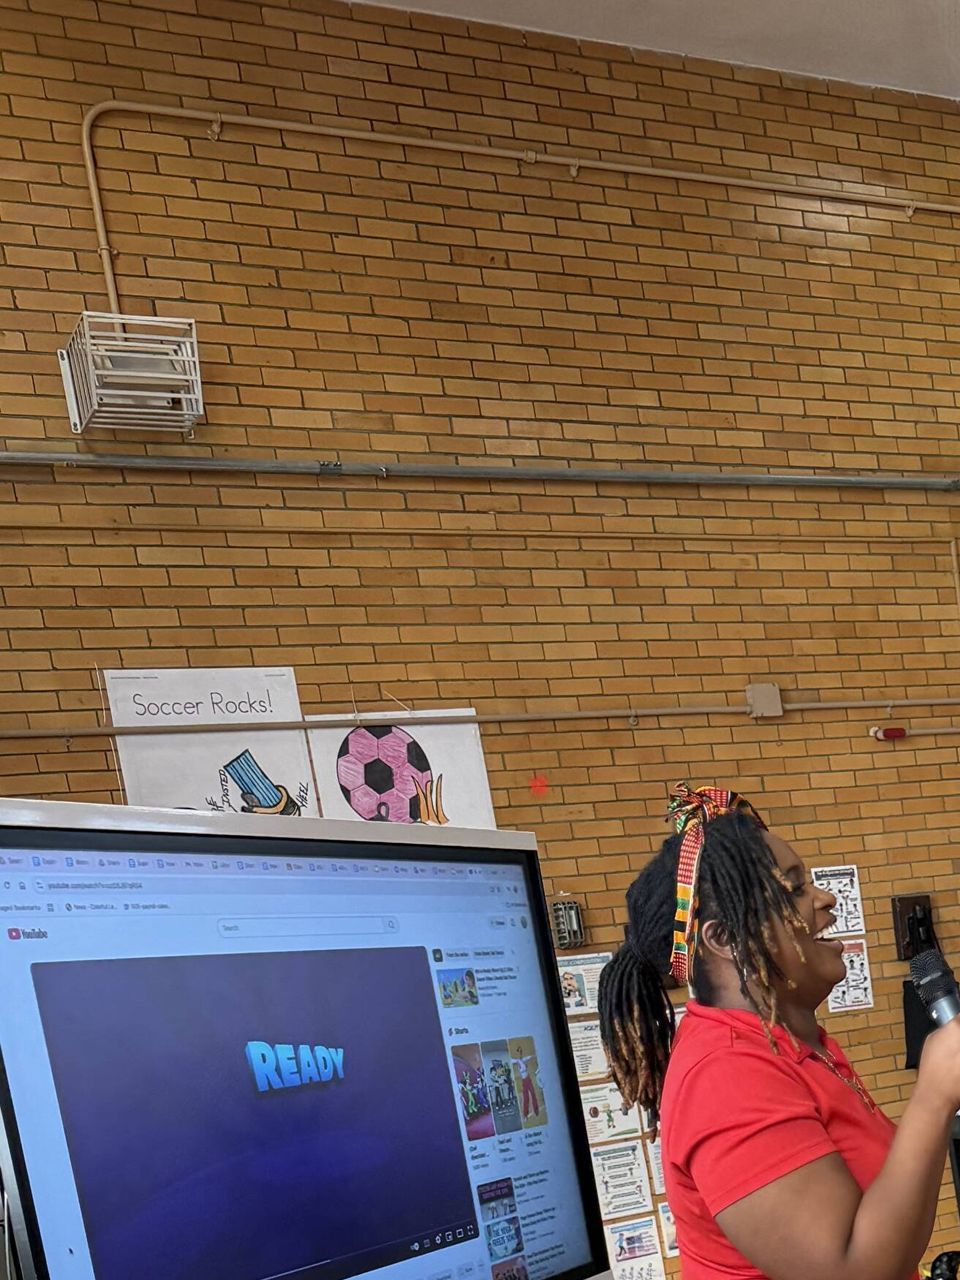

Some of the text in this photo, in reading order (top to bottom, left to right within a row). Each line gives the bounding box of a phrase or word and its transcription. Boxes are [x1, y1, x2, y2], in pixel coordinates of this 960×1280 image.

[132, 688, 273, 716] Soccer Rocks!
[21, 928, 48, 940] YouTube
[245, 1040, 344, 1092] READY
